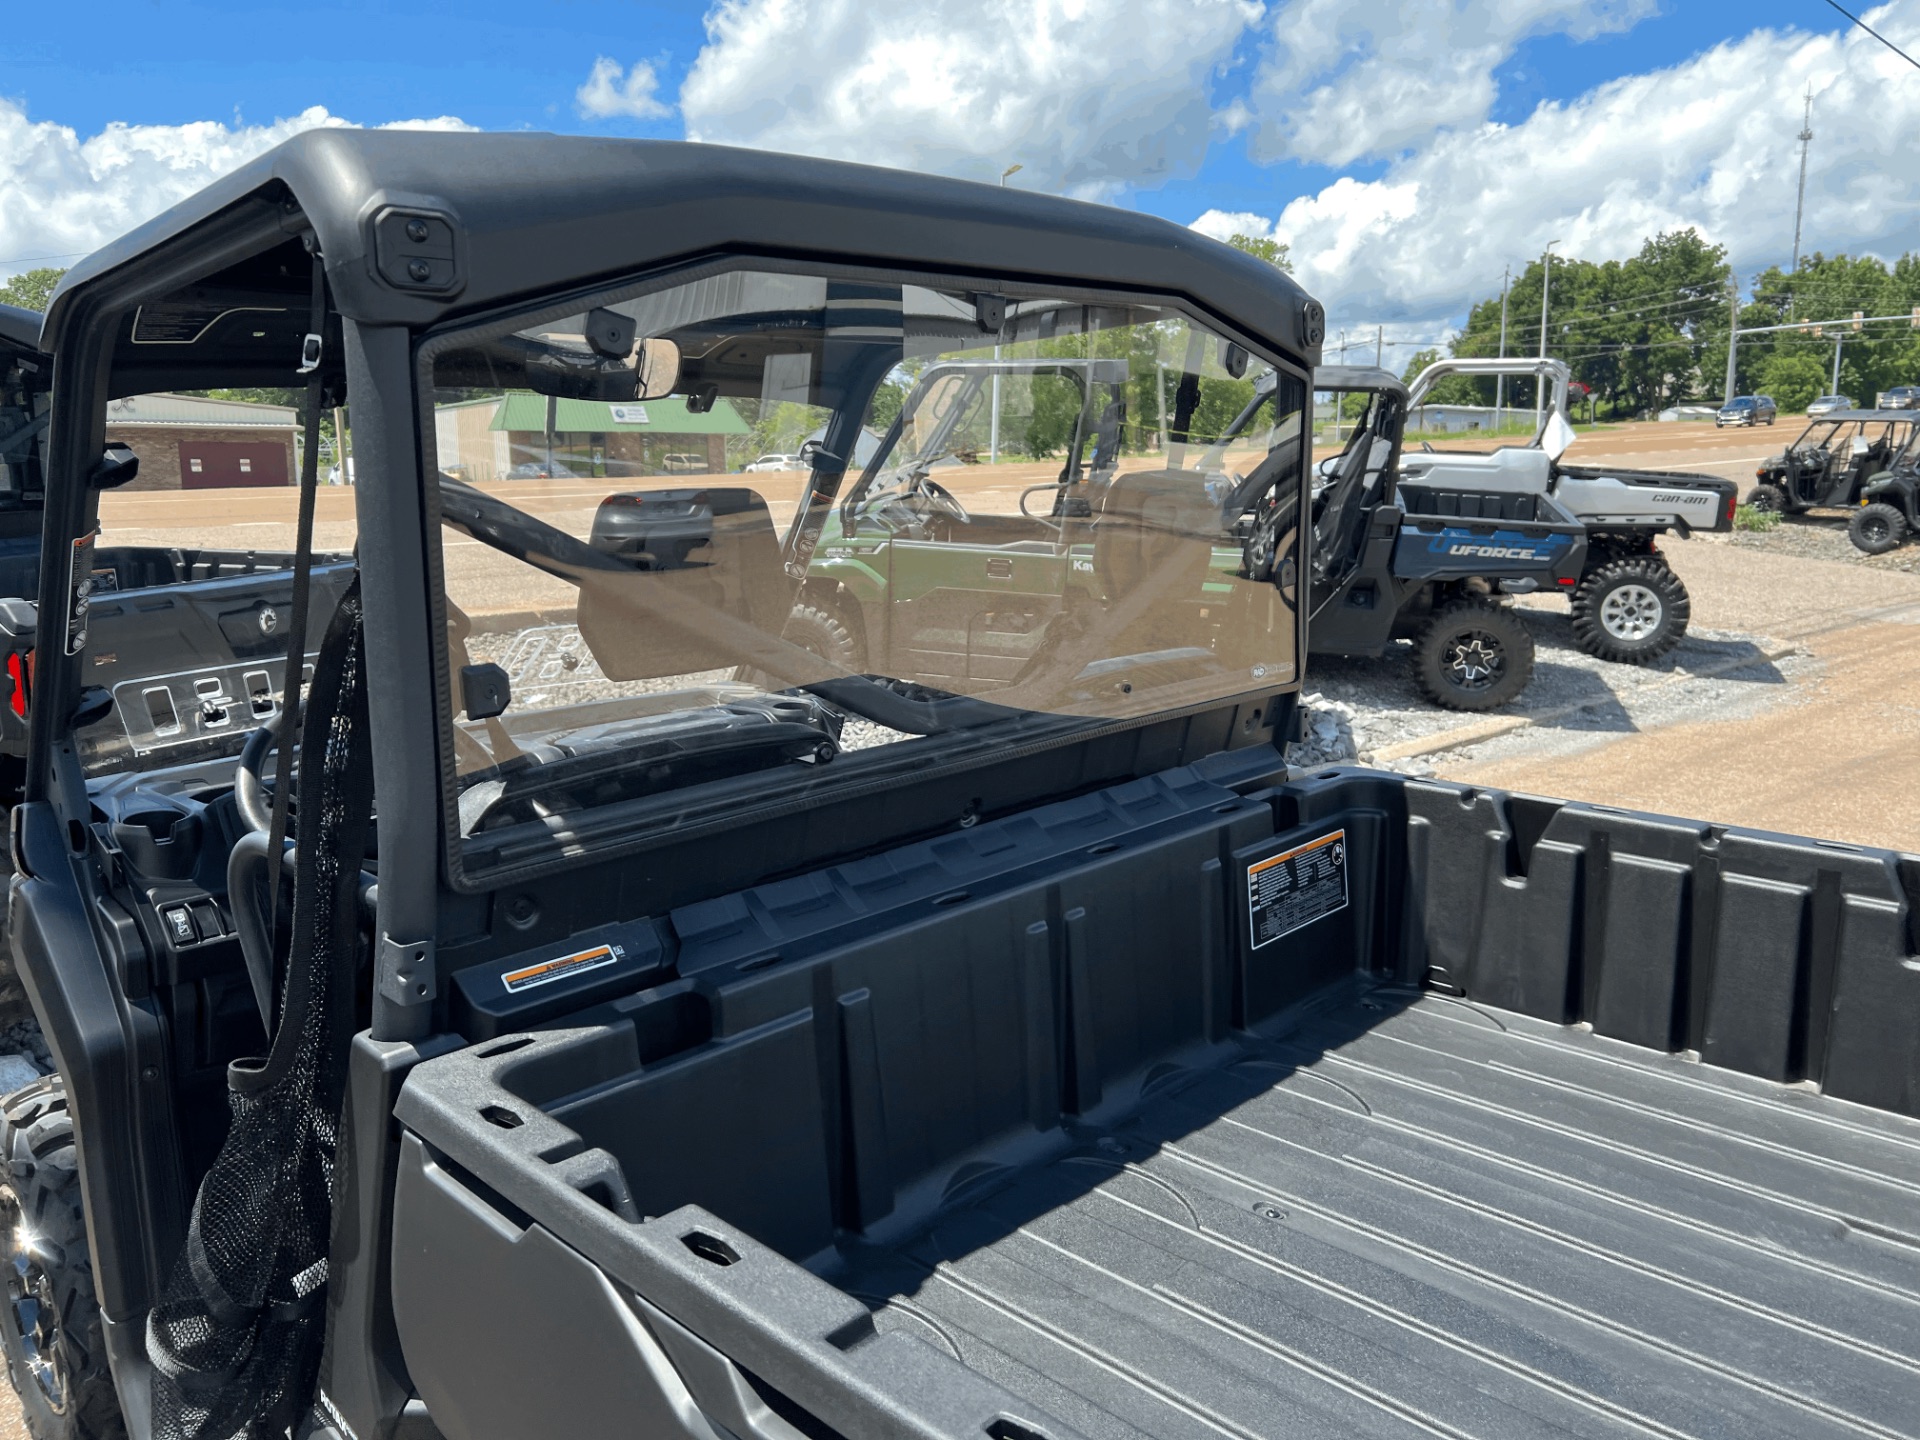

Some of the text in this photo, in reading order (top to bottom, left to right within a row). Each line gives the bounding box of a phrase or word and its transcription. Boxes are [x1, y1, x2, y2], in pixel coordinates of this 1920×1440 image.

[1652, 494, 1709, 505] can-am
[1449, 544, 1536, 560] UFORCE
[320, 1388, 349, 1437] ROTAX
